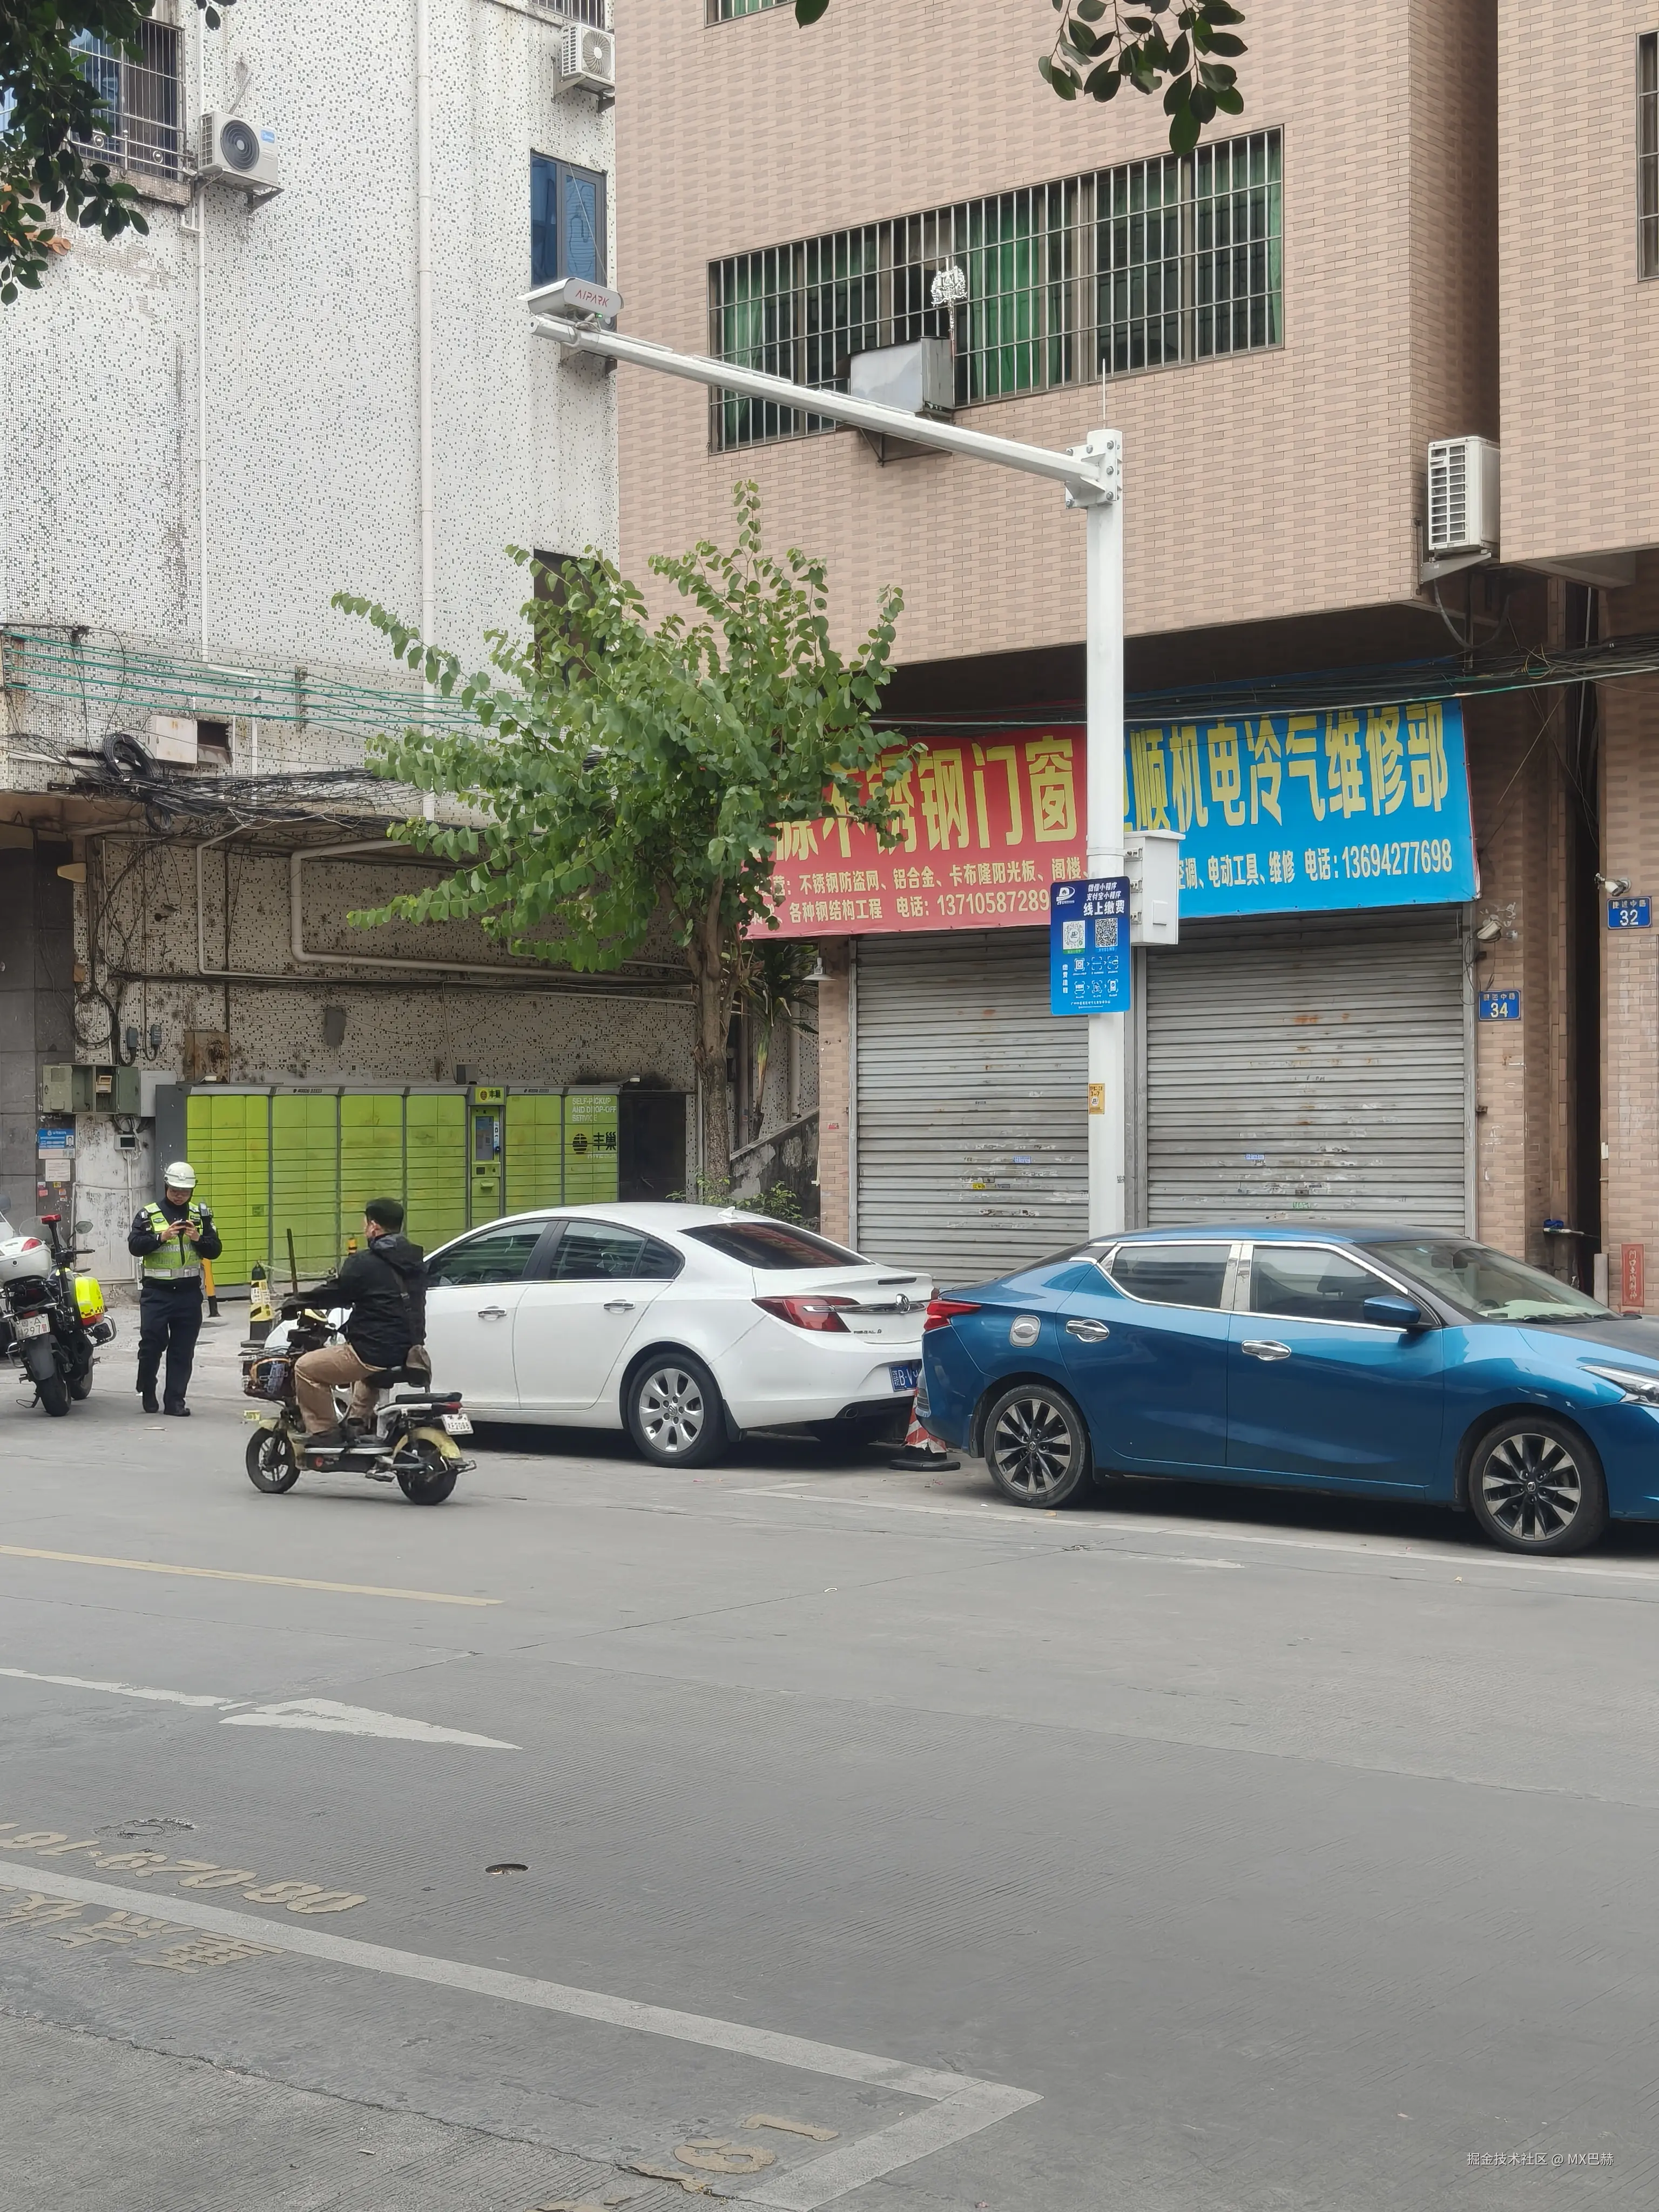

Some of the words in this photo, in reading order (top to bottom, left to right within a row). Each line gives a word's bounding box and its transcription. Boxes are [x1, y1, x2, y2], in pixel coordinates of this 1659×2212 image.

[575, 289, 610, 308] AIPARK
[1124, 702, 1448, 832] 顺机电冷气维修部
[1086, 890, 1122, 902] 支付宝小程序
[789, 898, 883, 924] 各种钢结构工程
[1083, 899, 1125, 916] 线上缴费
[1620, 909, 1638, 926] 32
[1490, 1002, 1508, 1018] 34
[593, 1131, 617, 1151] 丰巢
